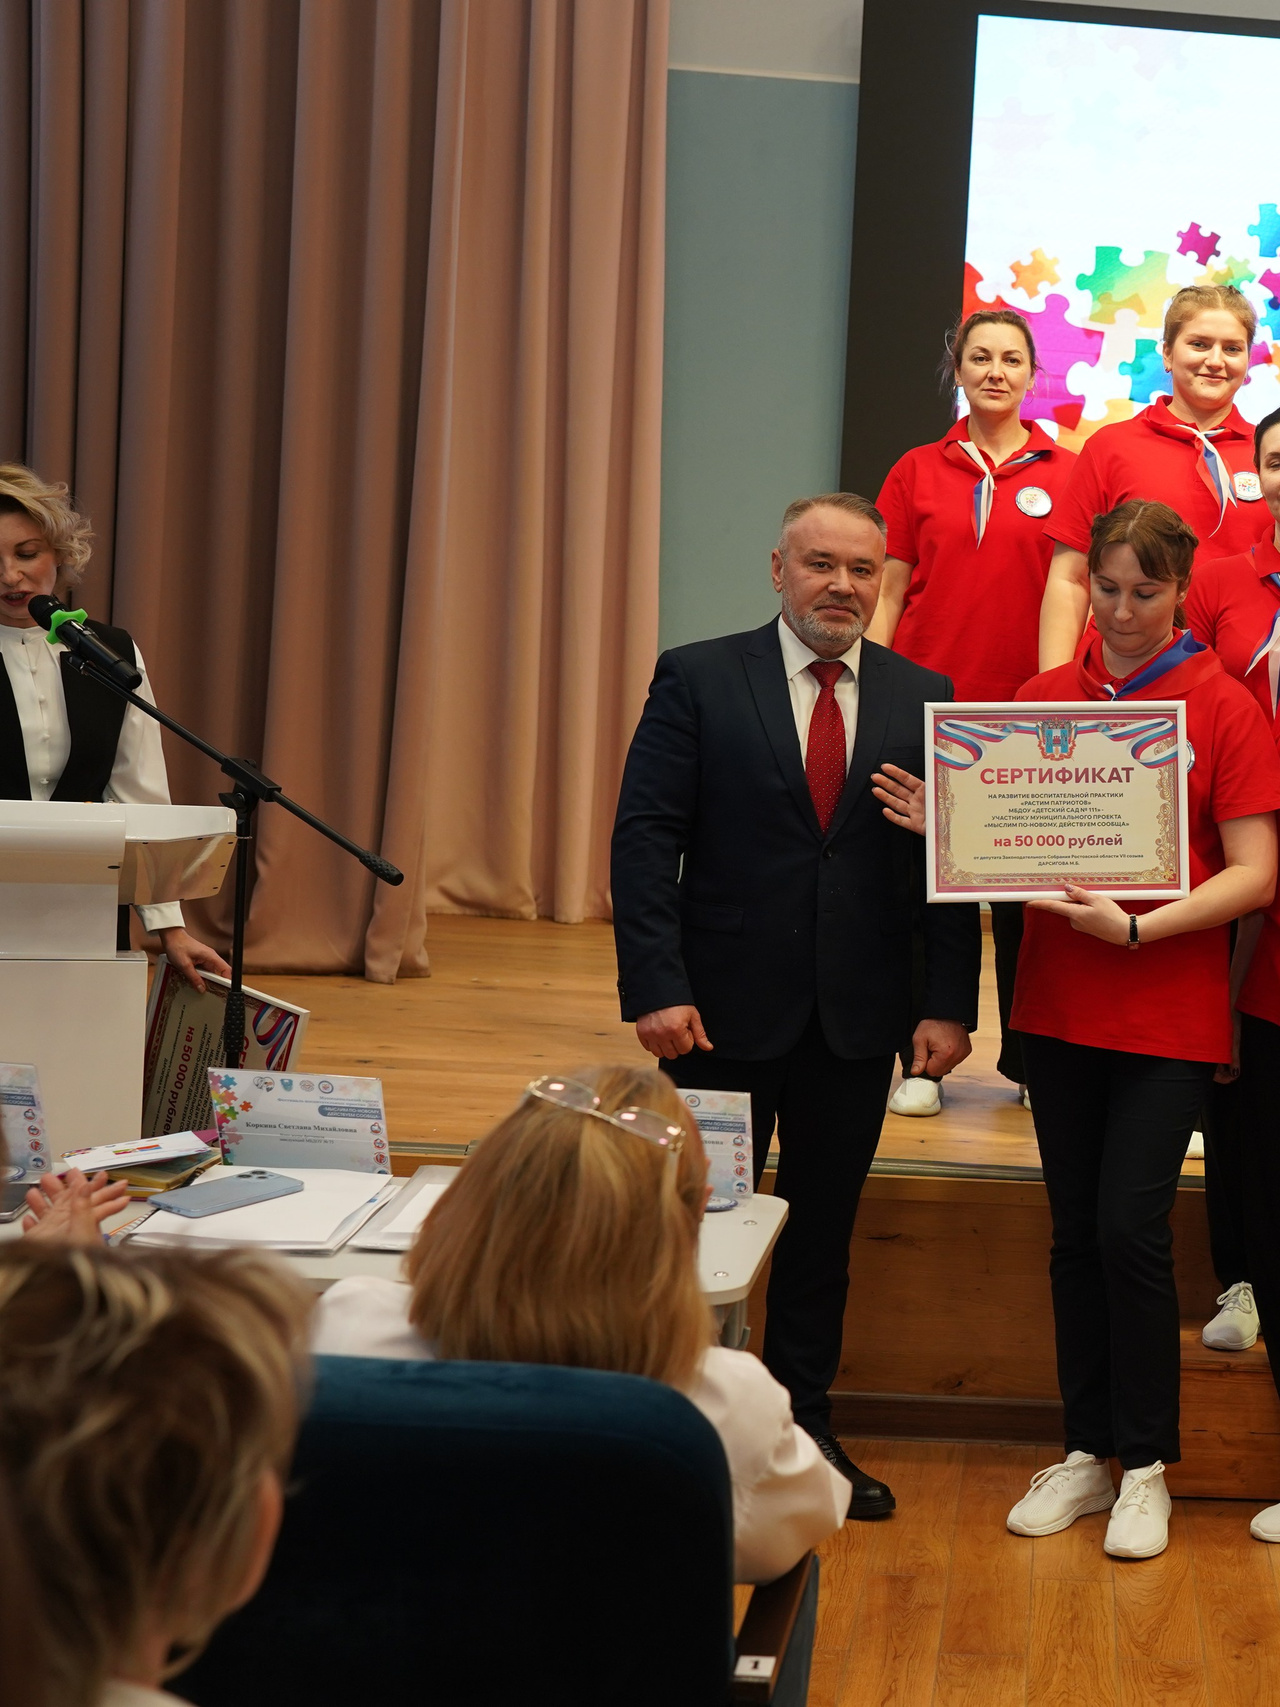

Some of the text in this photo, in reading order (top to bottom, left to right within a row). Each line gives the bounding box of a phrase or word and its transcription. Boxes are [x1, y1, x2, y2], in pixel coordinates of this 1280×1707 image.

[980, 767, 1135, 785] СЕРТИФИКАТ
[993, 834, 1123, 848] на 50 000 рублей
[185, 1026, 195, 1043] на
[181, 1044, 193, 1062] 50
[174, 1063, 188, 1090] 000
[246, 1121, 358, 1133] Коркина Светлана Михайловна
[751, 1660, 760, 1670] 1
